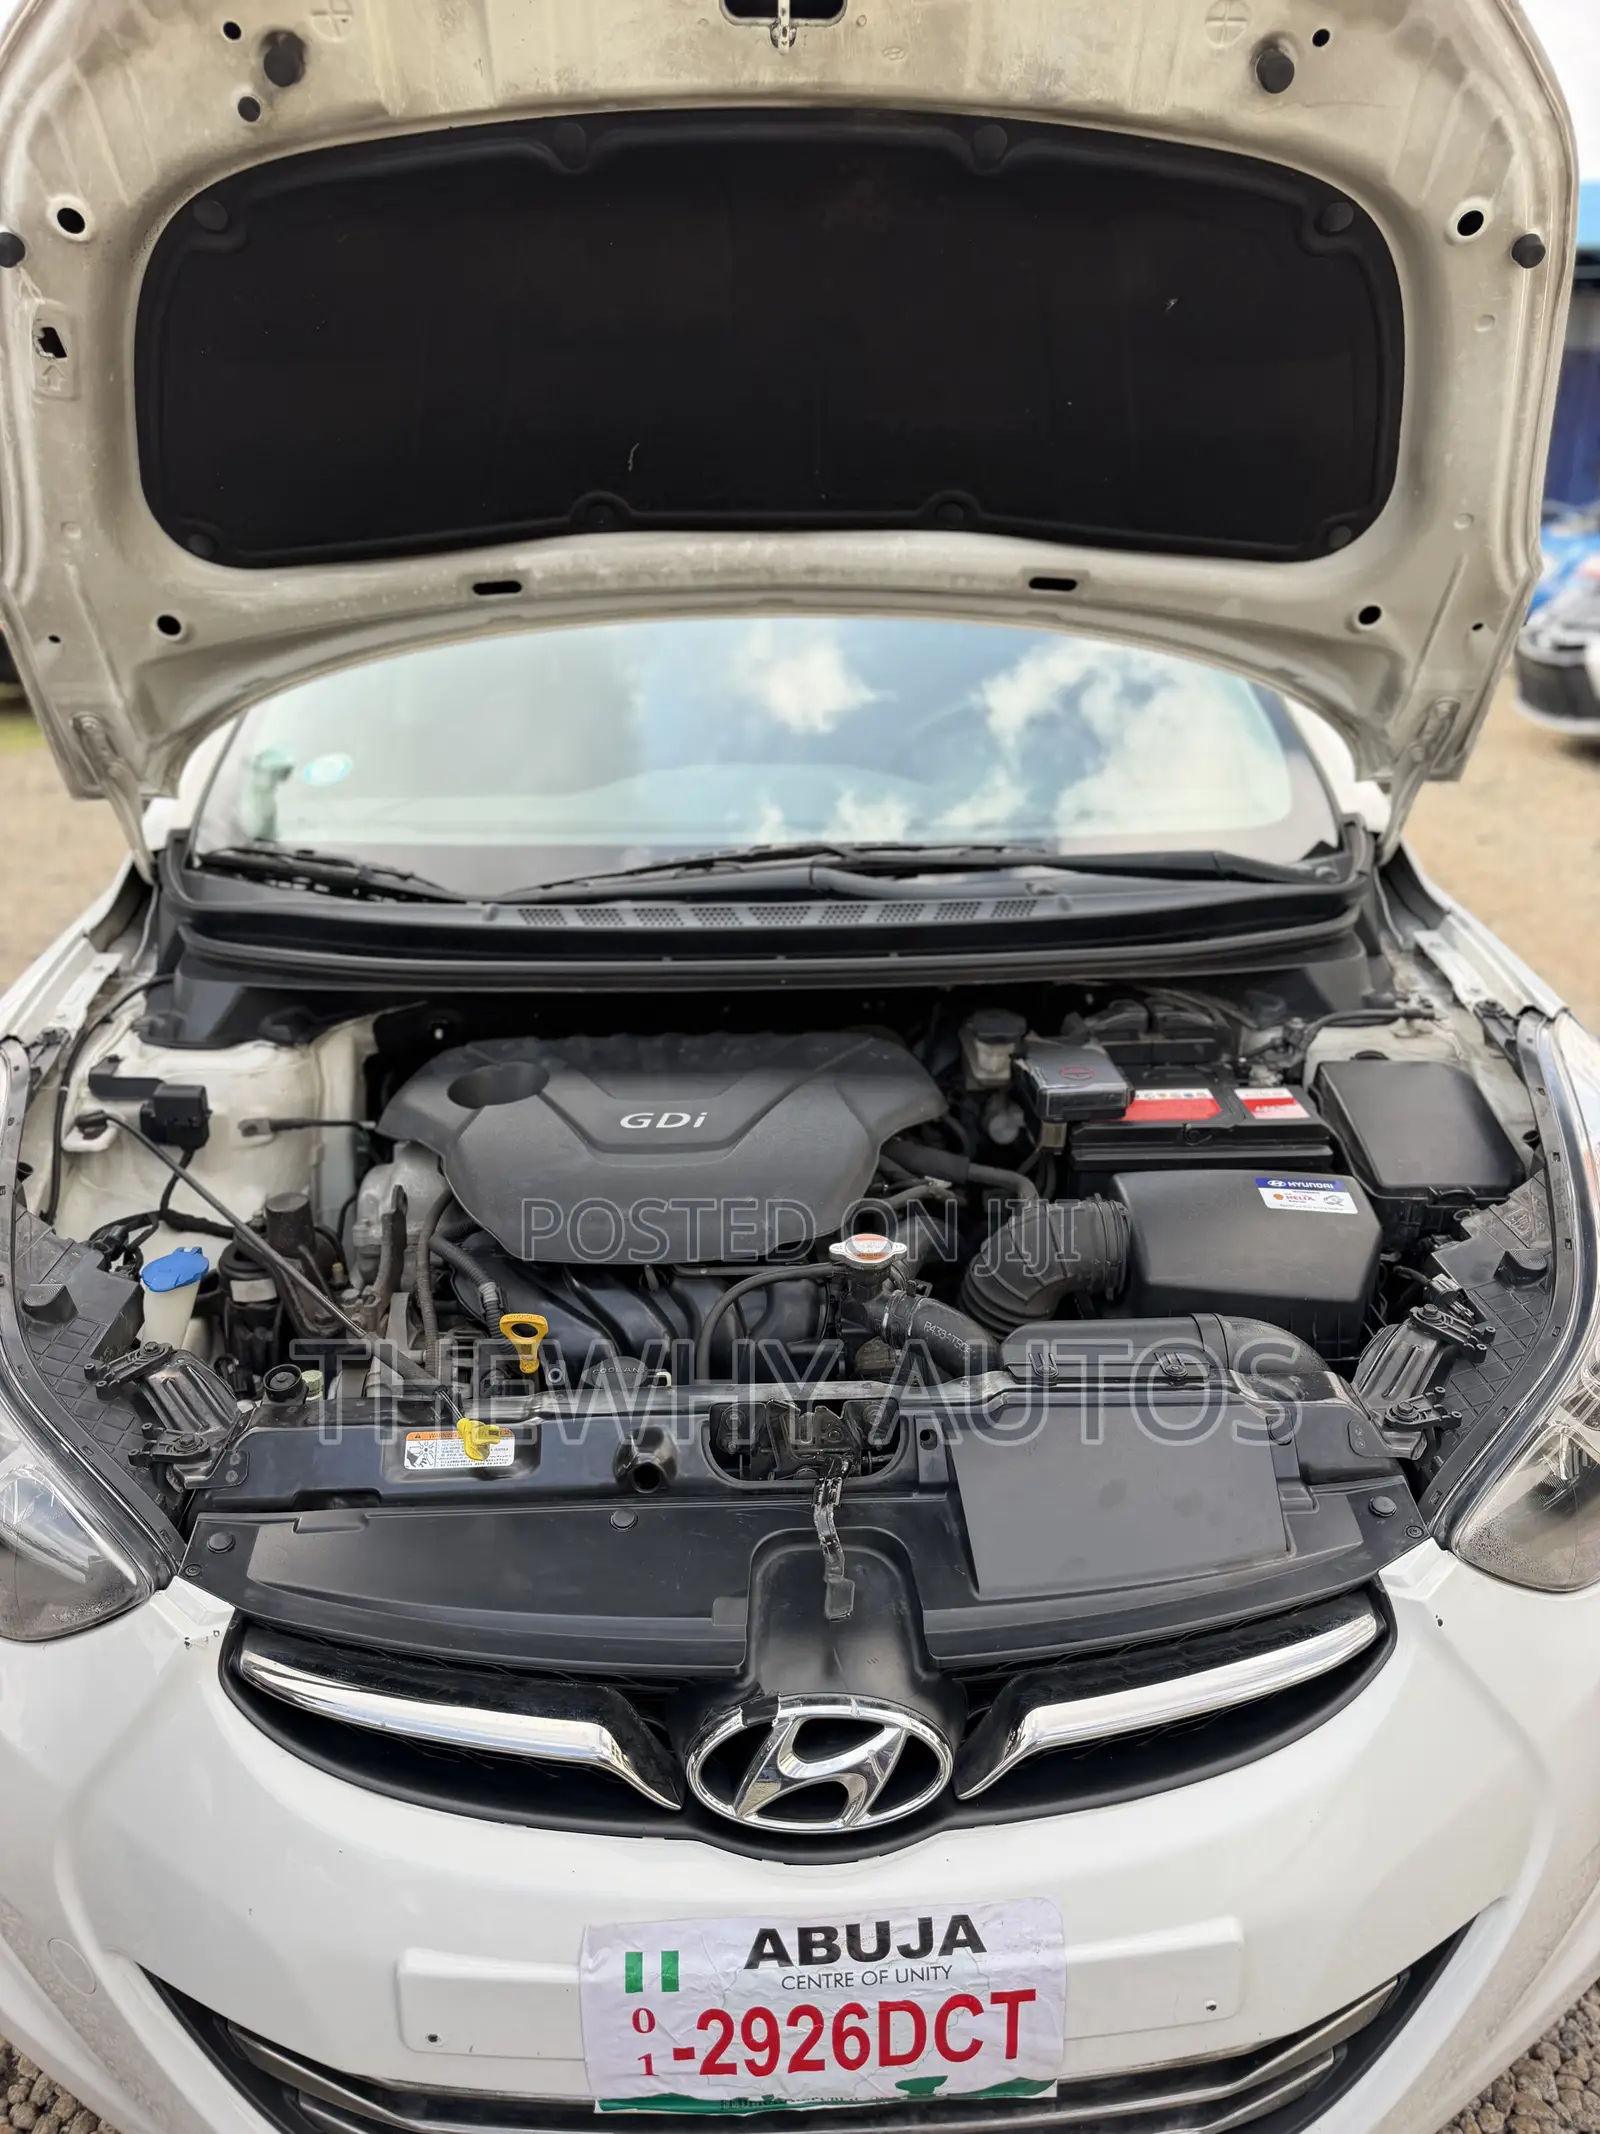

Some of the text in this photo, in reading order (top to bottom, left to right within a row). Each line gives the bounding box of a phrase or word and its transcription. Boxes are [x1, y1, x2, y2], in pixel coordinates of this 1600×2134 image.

[620, 1112, 708, 1129] GDi
[1287, 1181, 1334, 1189] HYUNDAI
[744, 1914, 987, 1970] ABUJA
[781, 1964, 954, 1992] CENTRE OF UNITY
